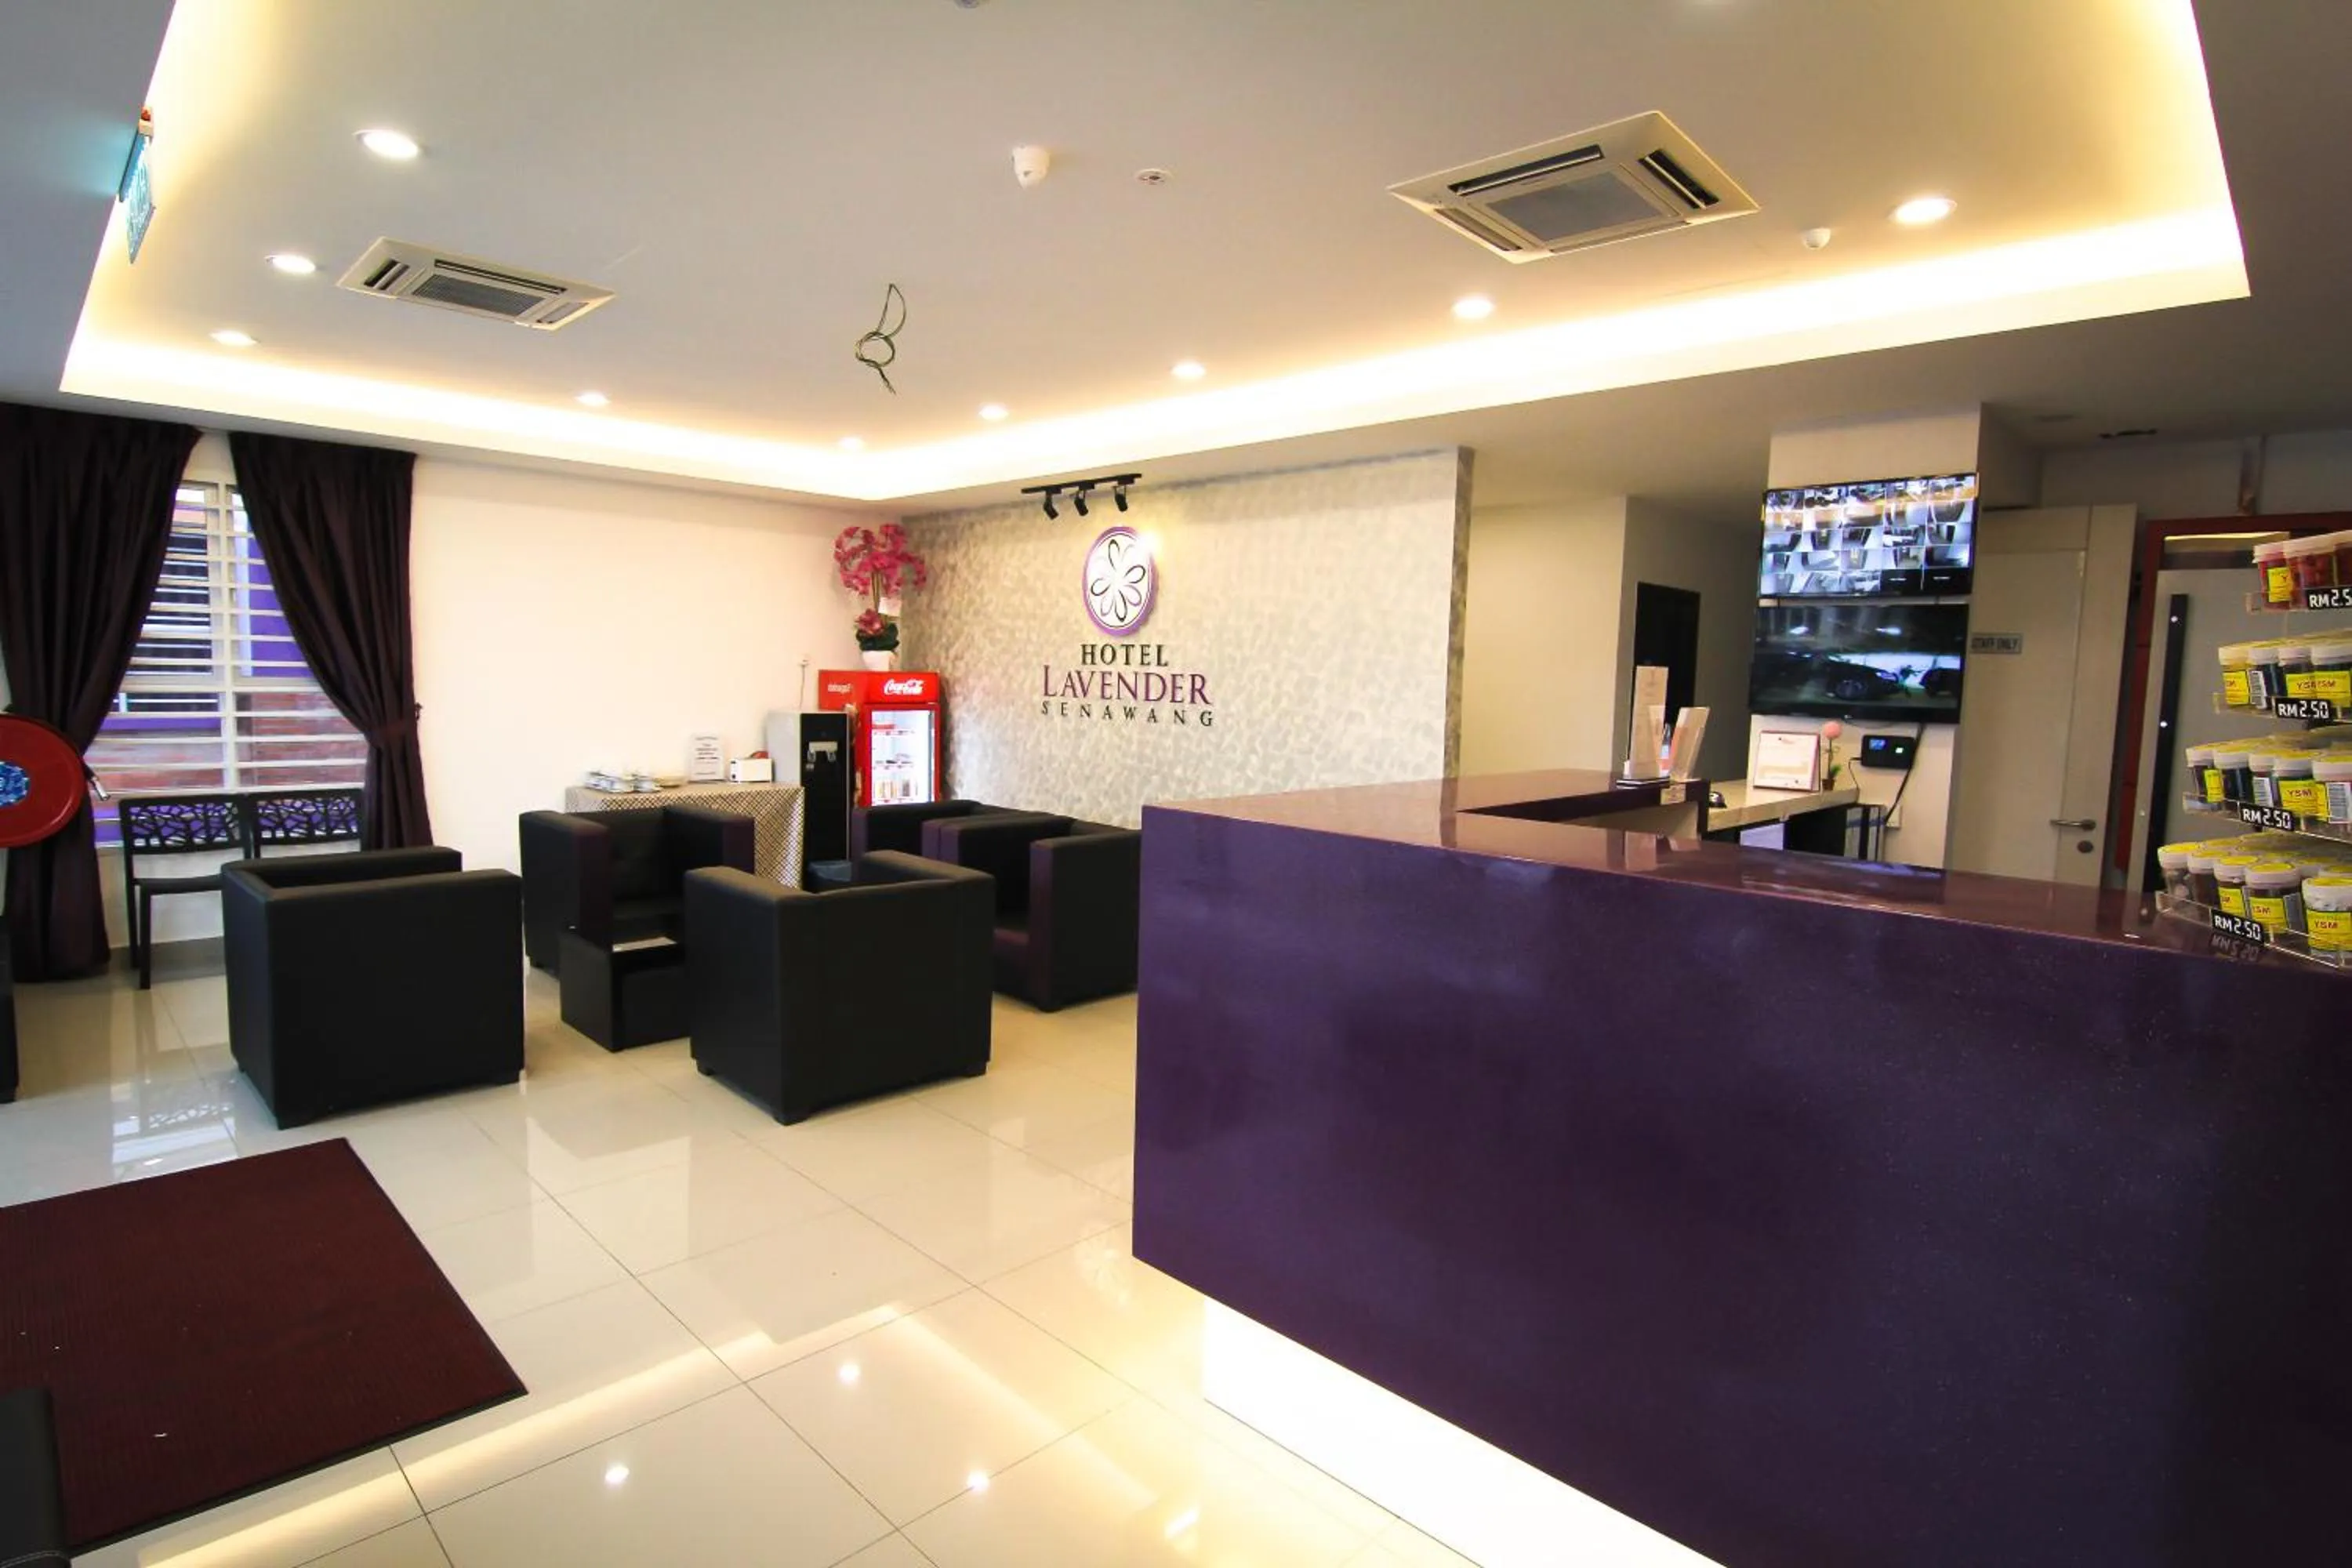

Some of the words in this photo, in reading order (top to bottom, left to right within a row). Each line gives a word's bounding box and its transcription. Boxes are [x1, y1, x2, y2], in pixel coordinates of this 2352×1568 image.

[1080, 644, 1170, 666] HOTEL
[1041, 665, 1214, 706] LAVENDER
[1041, 701, 1214, 727] SENAWANG
